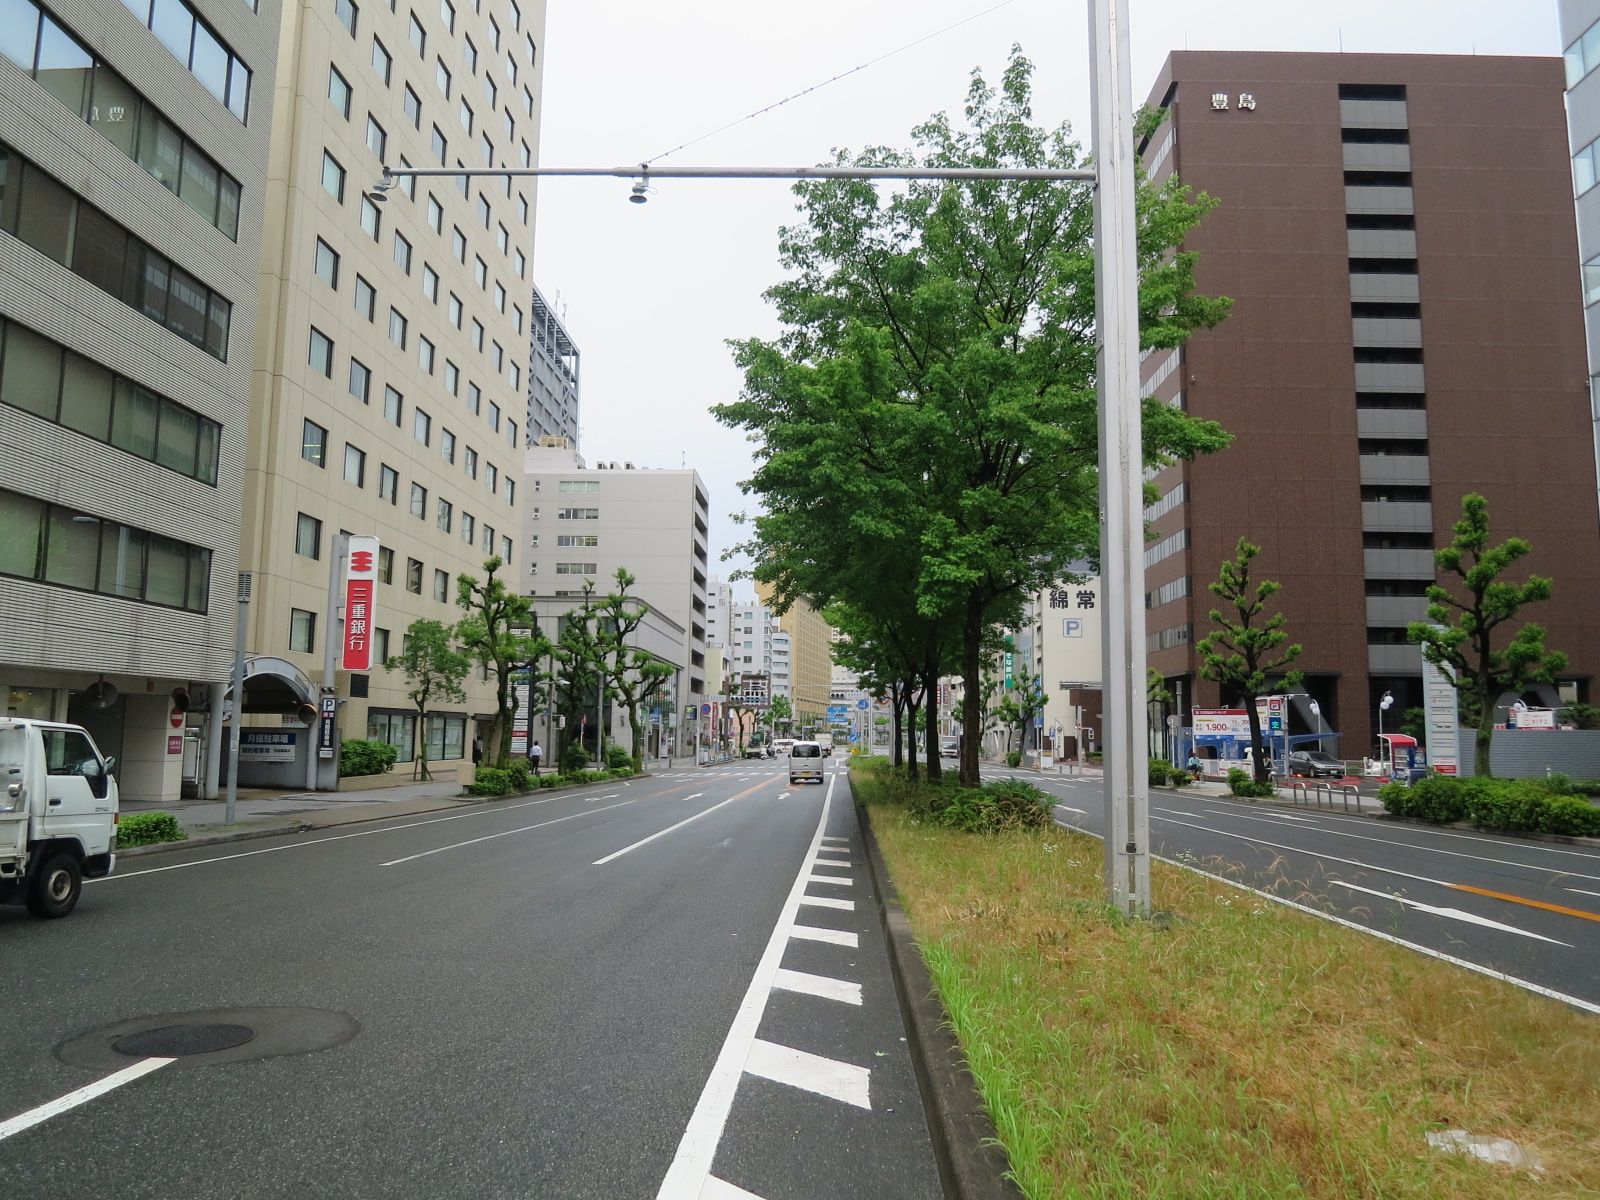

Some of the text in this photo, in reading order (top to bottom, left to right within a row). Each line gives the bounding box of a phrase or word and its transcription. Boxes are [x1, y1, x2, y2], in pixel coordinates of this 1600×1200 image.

[1210, 93, 1256, 110] 豊島
[1049, 590, 1095, 609] 綿常
[349, 587, 368, 651] 三重銀行
[1066, 620, 1080, 636] P
[326, 700, 333, 710] P
